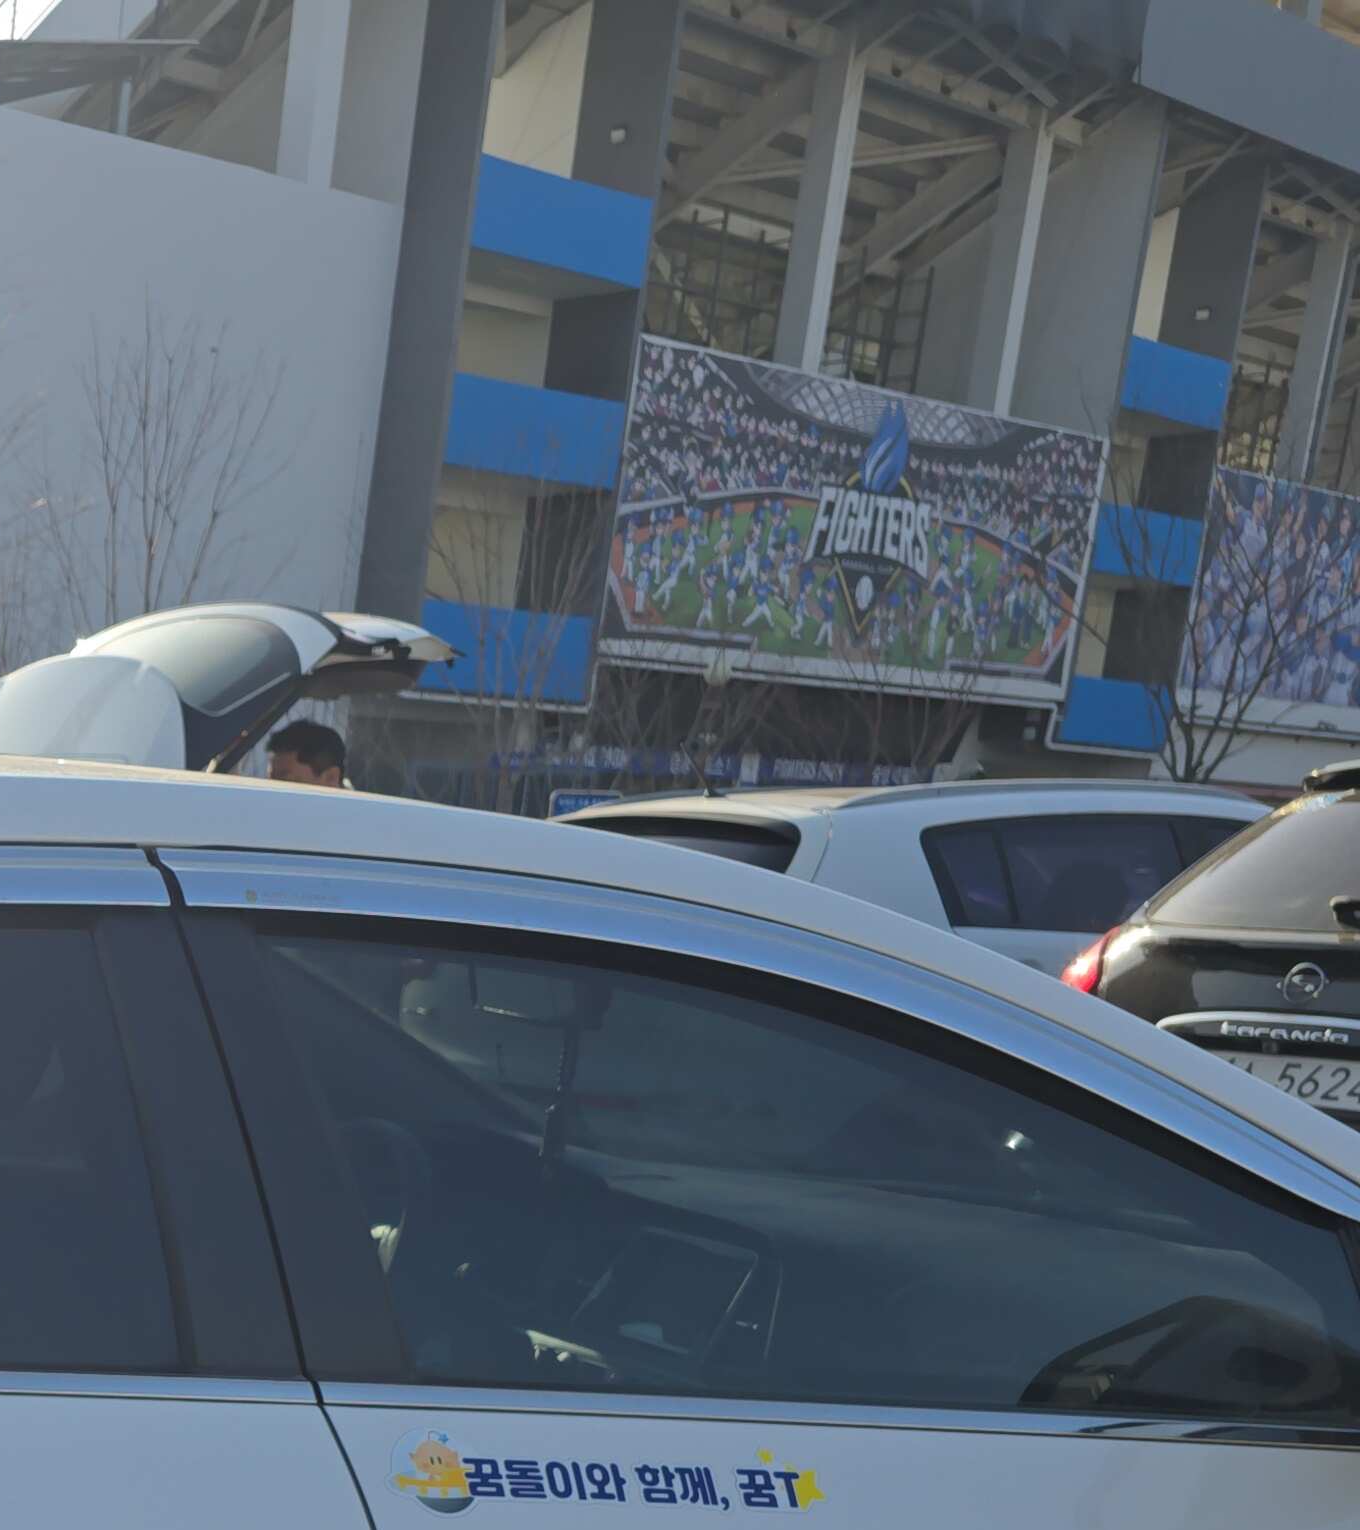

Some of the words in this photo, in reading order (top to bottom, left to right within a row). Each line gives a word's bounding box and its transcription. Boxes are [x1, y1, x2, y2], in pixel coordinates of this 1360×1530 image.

[803, 485, 931, 581] FIGHTERS
[462, 1457, 627, 1502] 꿈돌이와
[635, 1463, 730, 1511] 함께,
[735, 1468, 801, 1508] 꿈T
